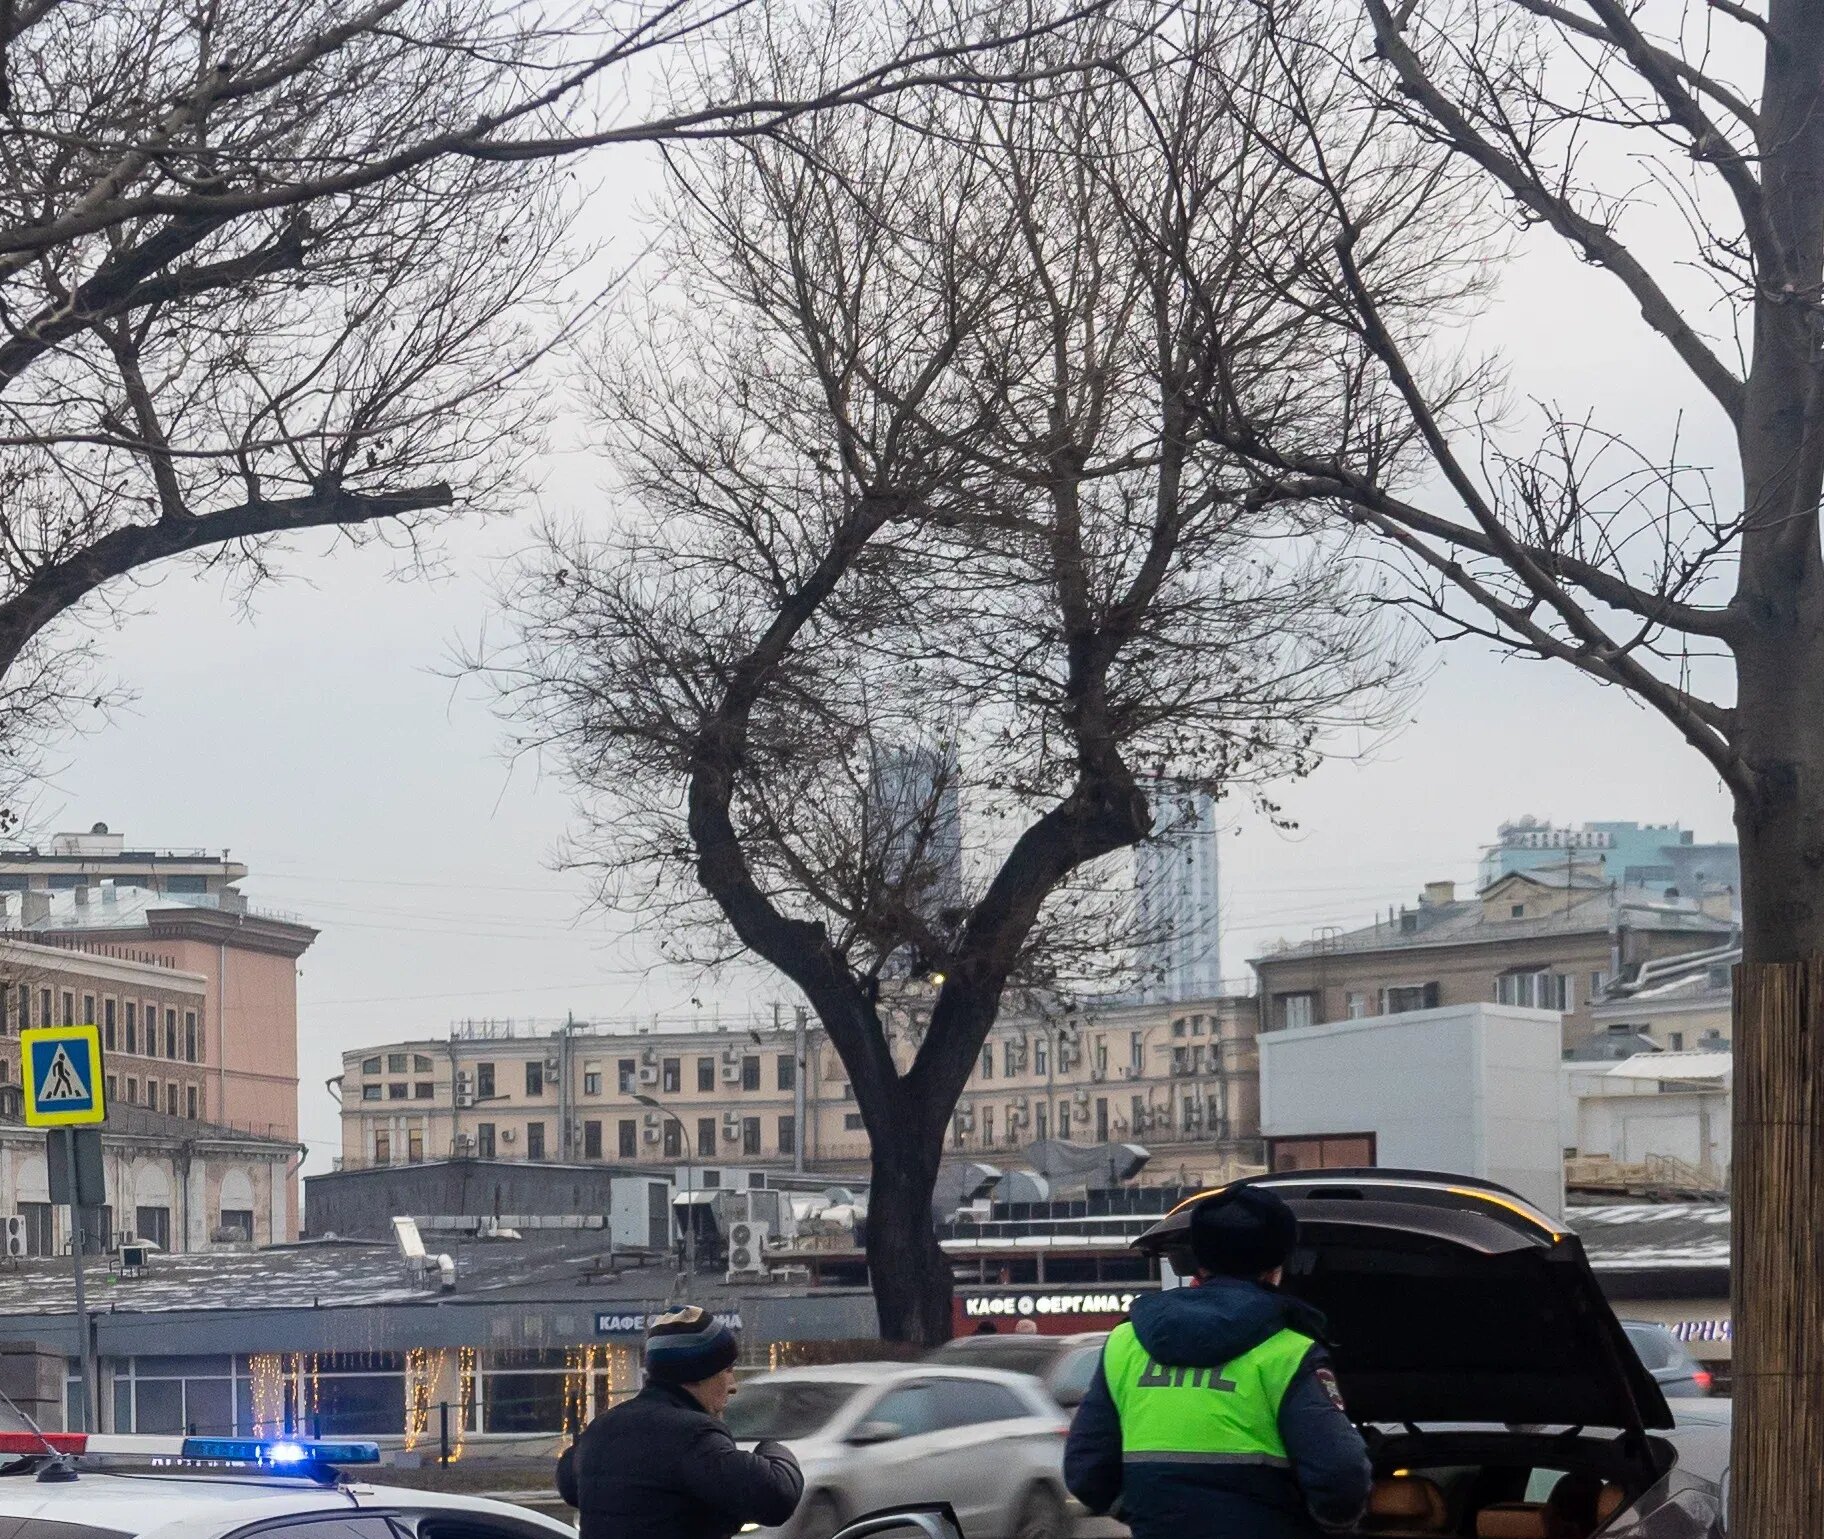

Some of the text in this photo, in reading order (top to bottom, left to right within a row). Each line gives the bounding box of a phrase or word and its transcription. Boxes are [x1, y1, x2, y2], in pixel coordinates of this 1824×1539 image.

[966, 1297, 1016, 1315] КАФЕ
[1036, 1294, 1121, 1313] ФЕРГАНА
[599, 1315, 645, 1330] КАФЕ
